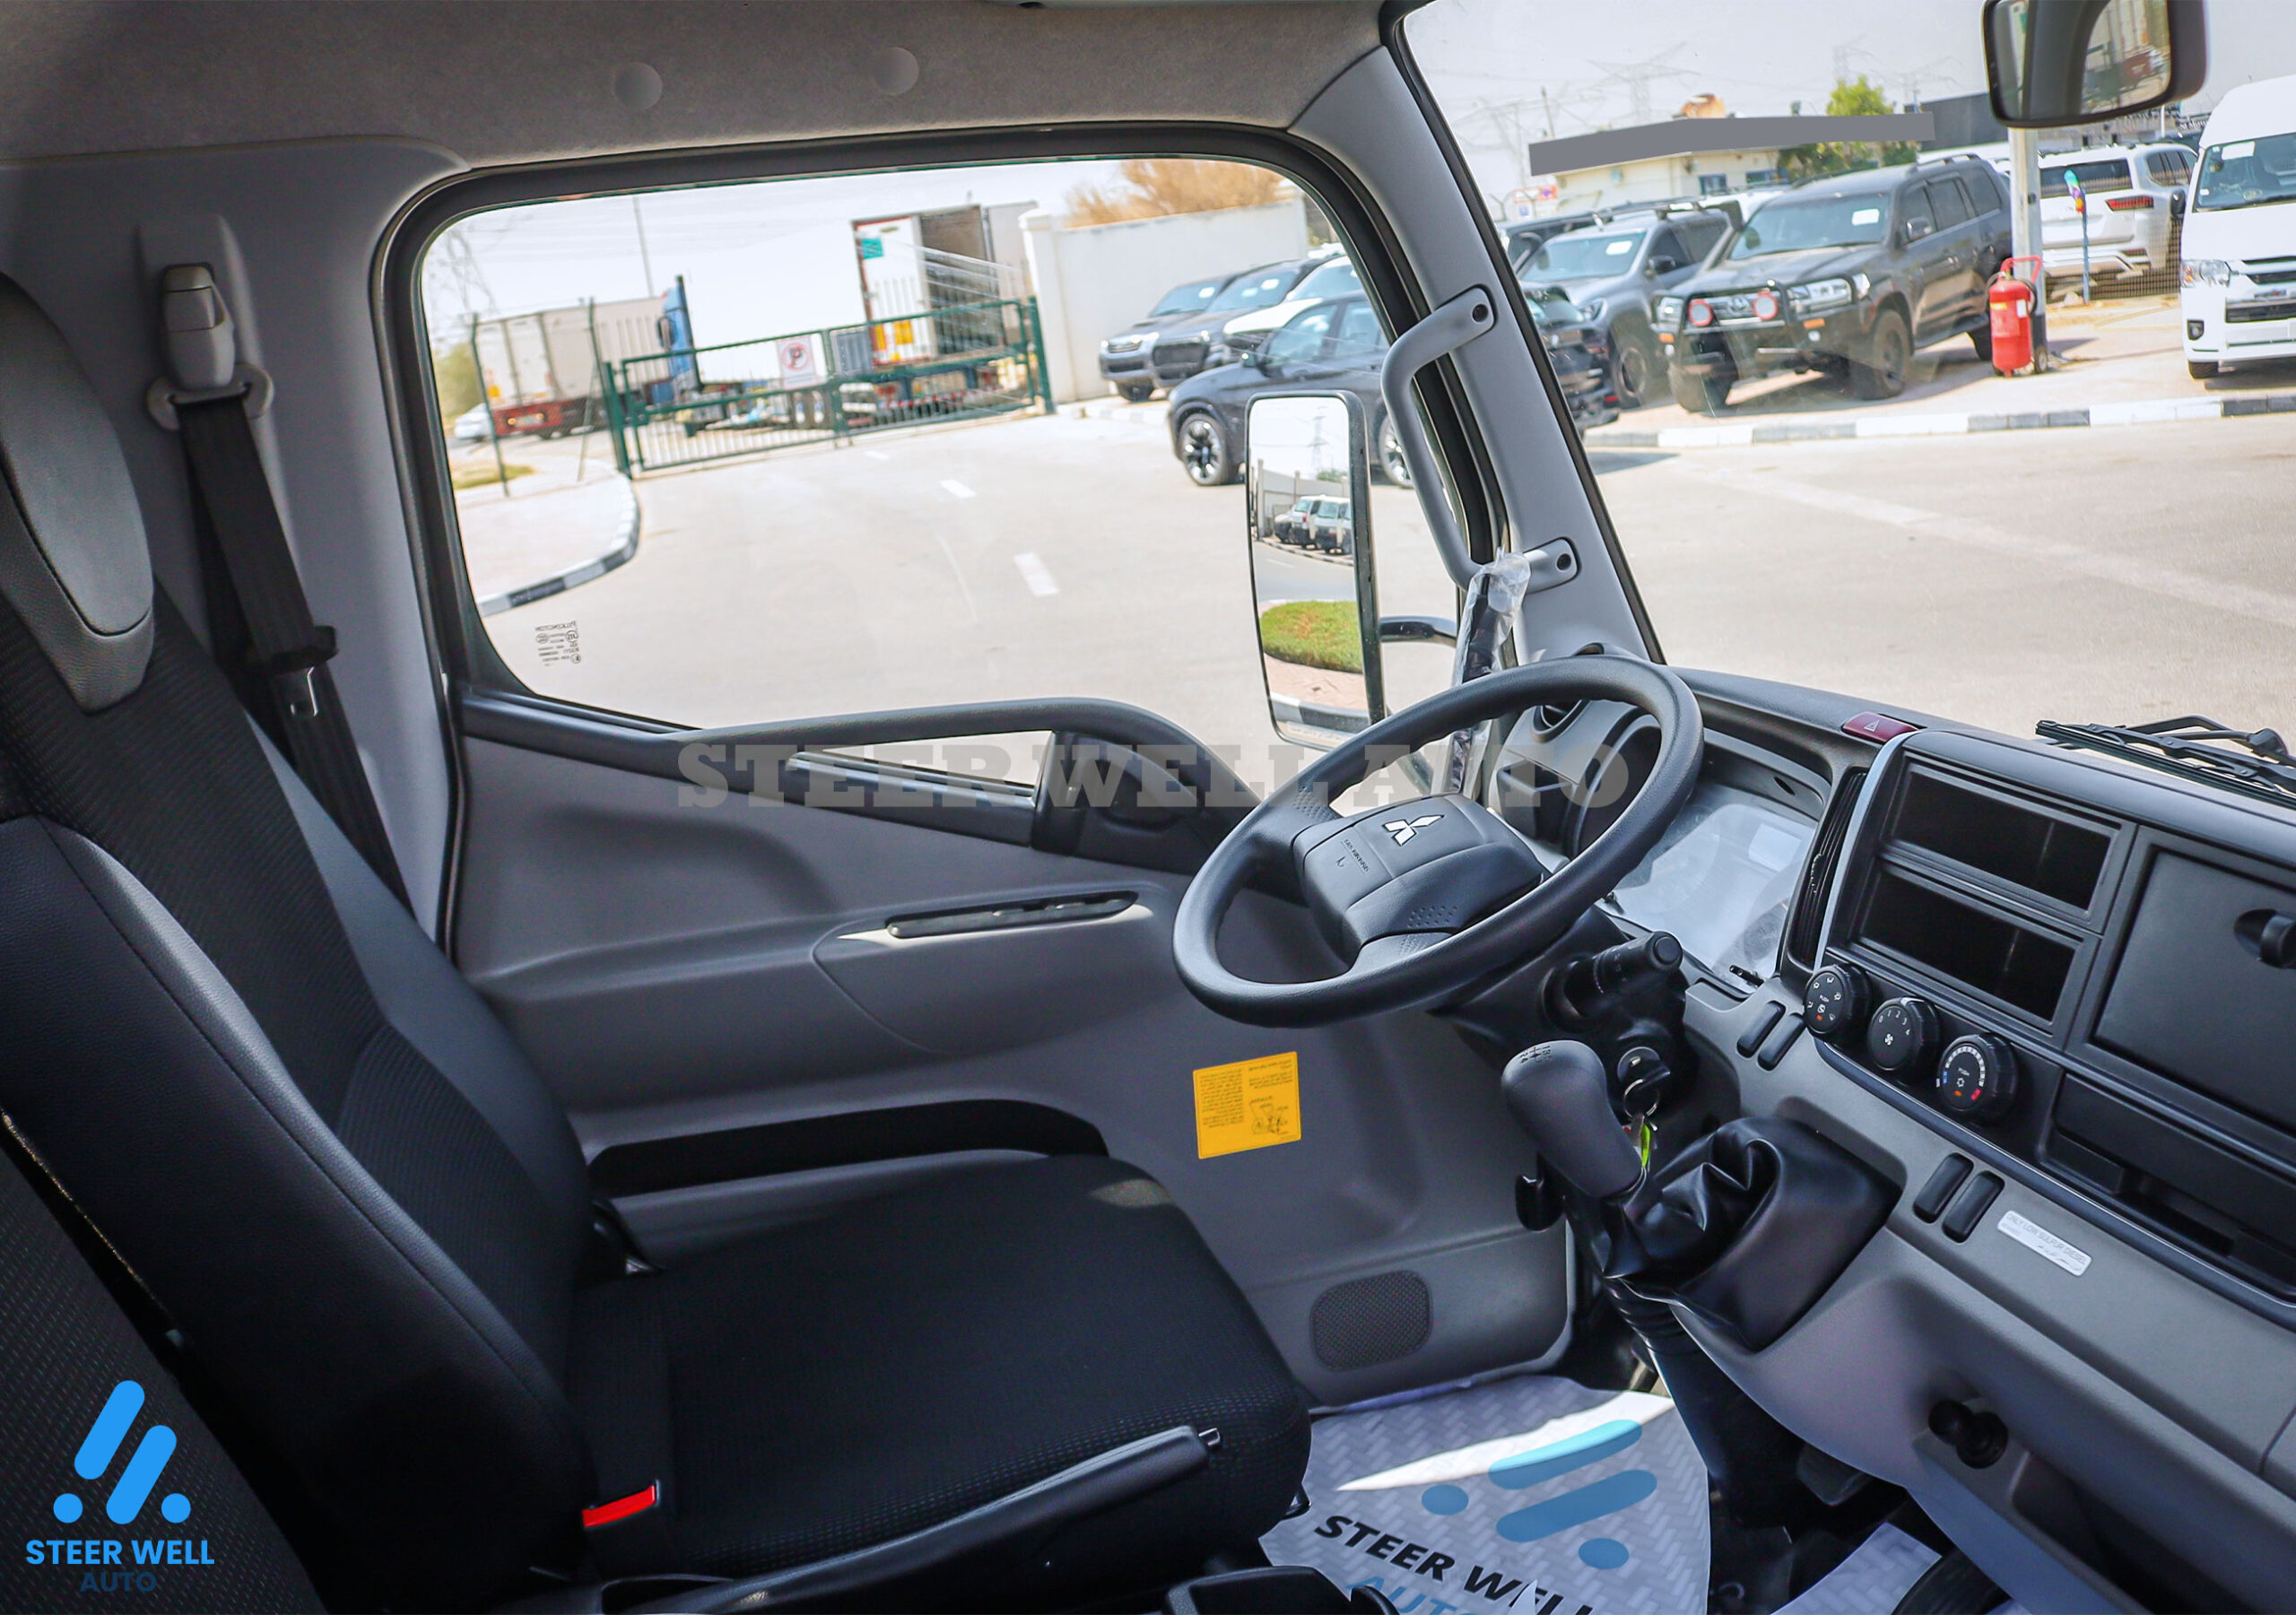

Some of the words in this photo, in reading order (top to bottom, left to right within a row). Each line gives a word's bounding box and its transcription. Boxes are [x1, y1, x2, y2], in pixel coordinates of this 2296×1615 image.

[1887, 1010, 1892, 1018] 1
[1895, 1010, 1900, 1019] 2
[1901, 1017, 1908, 1026] 3
[1905, 1029, 1910, 1037] 4
[1314, 1515, 1456, 1582] STEER
